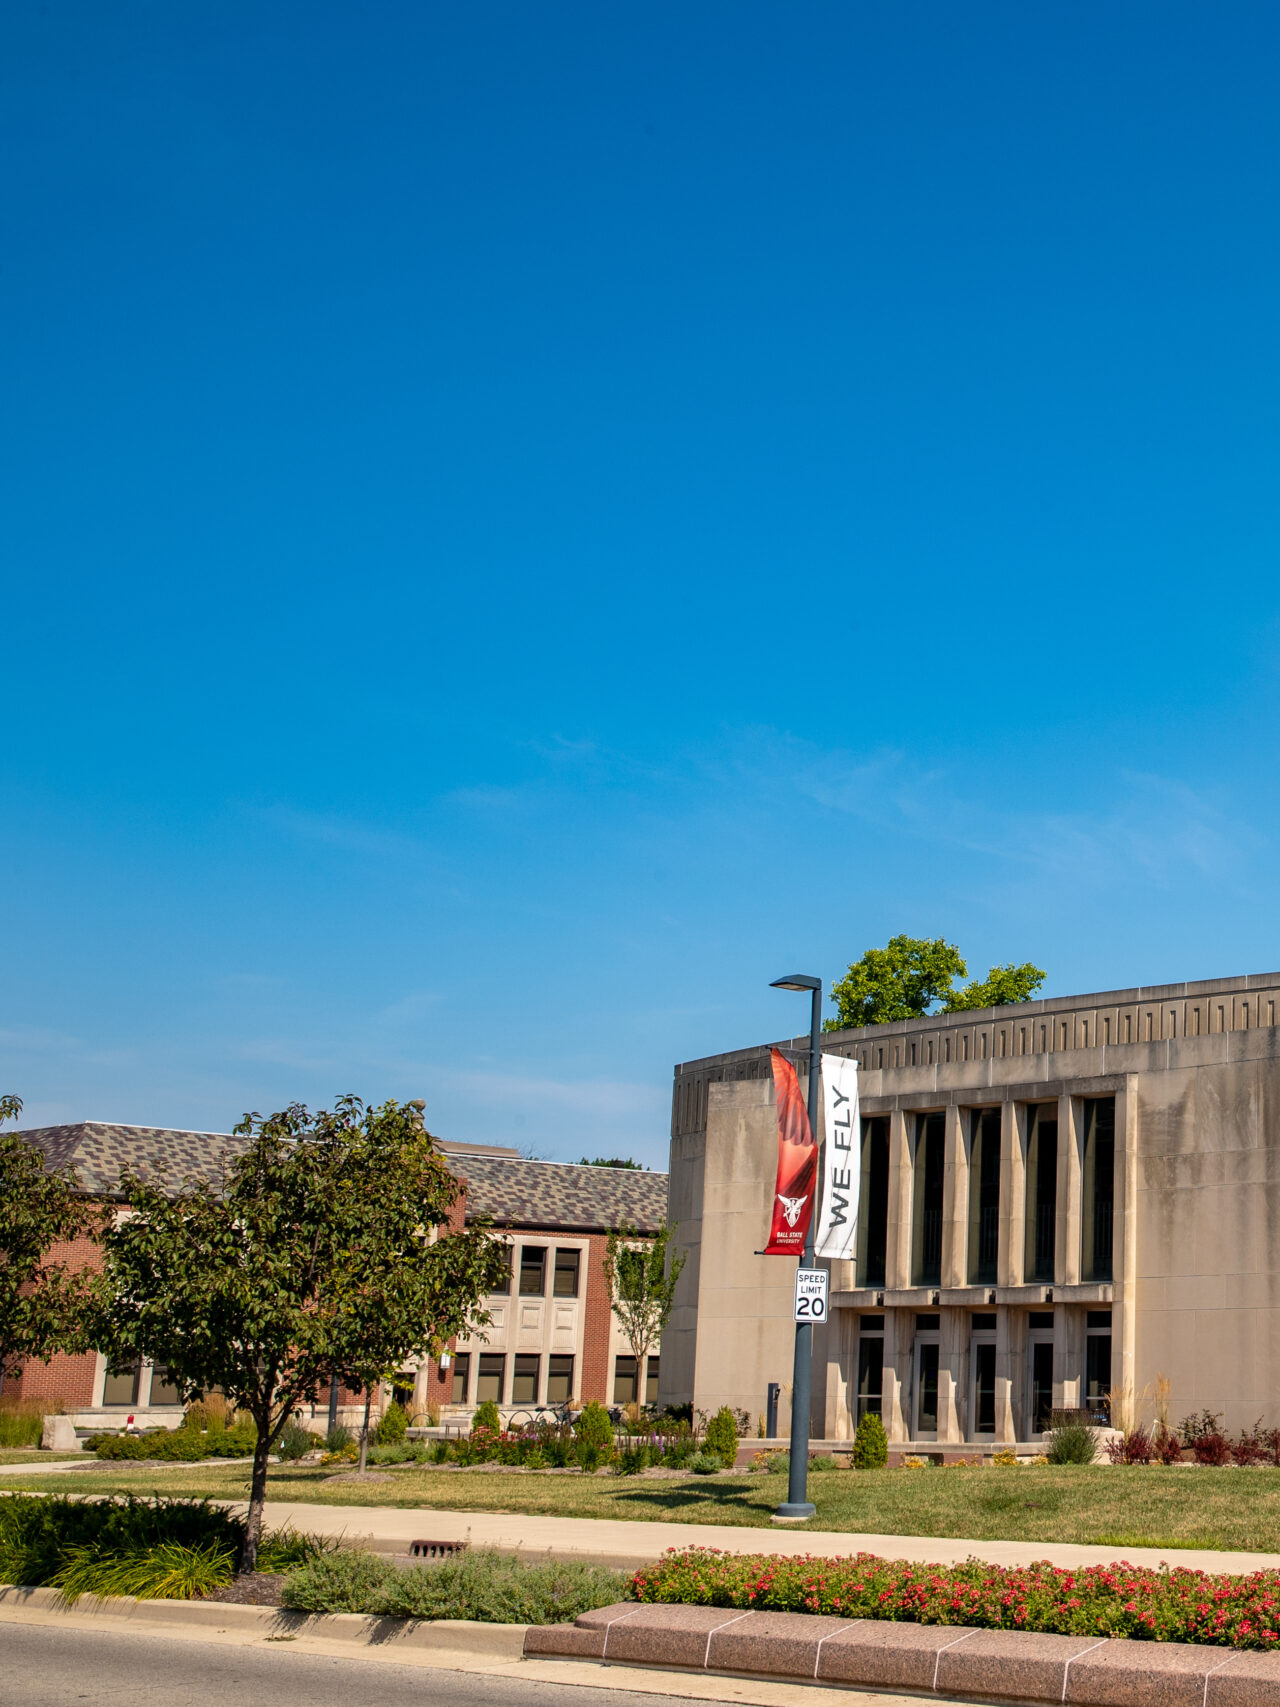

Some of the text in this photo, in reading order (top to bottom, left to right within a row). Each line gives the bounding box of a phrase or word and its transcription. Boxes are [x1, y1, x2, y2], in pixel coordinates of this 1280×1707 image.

[828, 1085, 851, 1228] WE FLY
[798, 1274, 825, 1283] SPEED
[801, 1286, 822, 1294] LIMIT
[797, 1297, 825, 1317] 20
